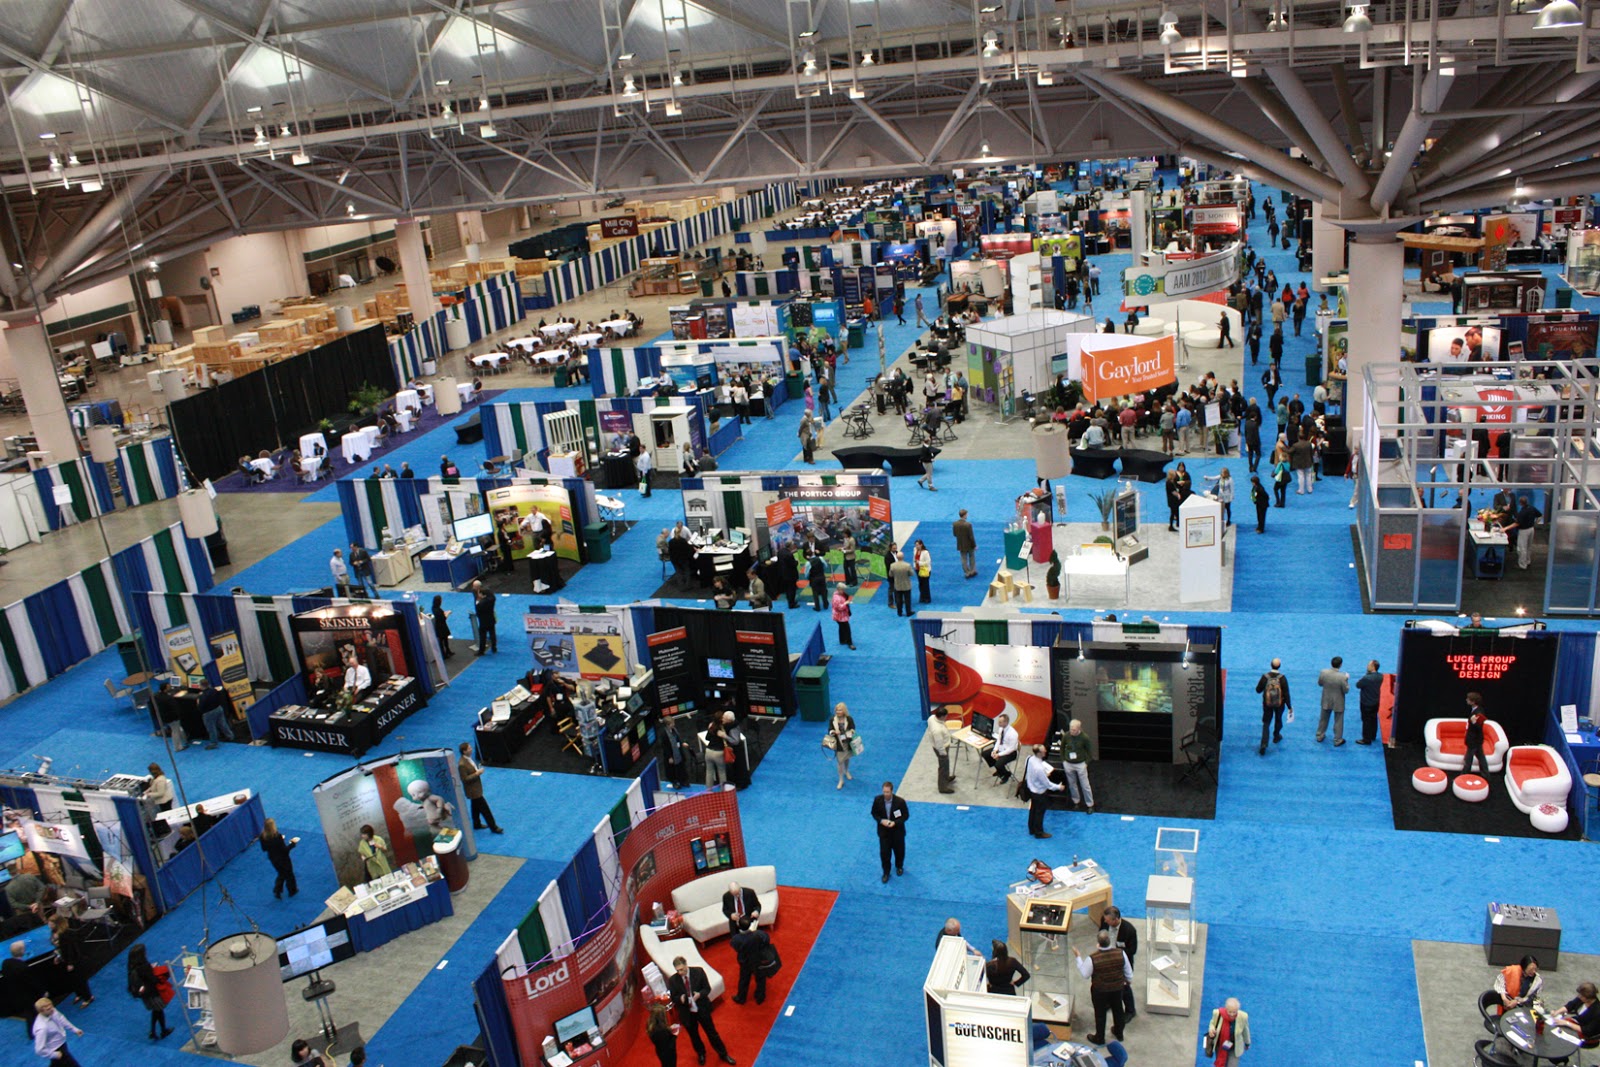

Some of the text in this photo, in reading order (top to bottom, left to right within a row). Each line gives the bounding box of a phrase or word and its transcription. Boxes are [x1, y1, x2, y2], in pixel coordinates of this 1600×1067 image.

[619, 219, 633, 228] City
[1173, 268, 1207, 289] AAM 2012
[1099, 350, 1161, 384] Gaylord
[320, 617, 371, 628] SKINNER
[1447, 655, 1516, 664] LUCE GROUP
[1453, 663, 1508, 671] LIGHTING
[1459, 671, 1501, 679] DESIGN
[1187, 677, 1198, 718] exhibit
[377, 692, 417, 729] SKINNER
[278, 726, 349, 748] SKINNER
[524, 961, 570, 996] Lord
